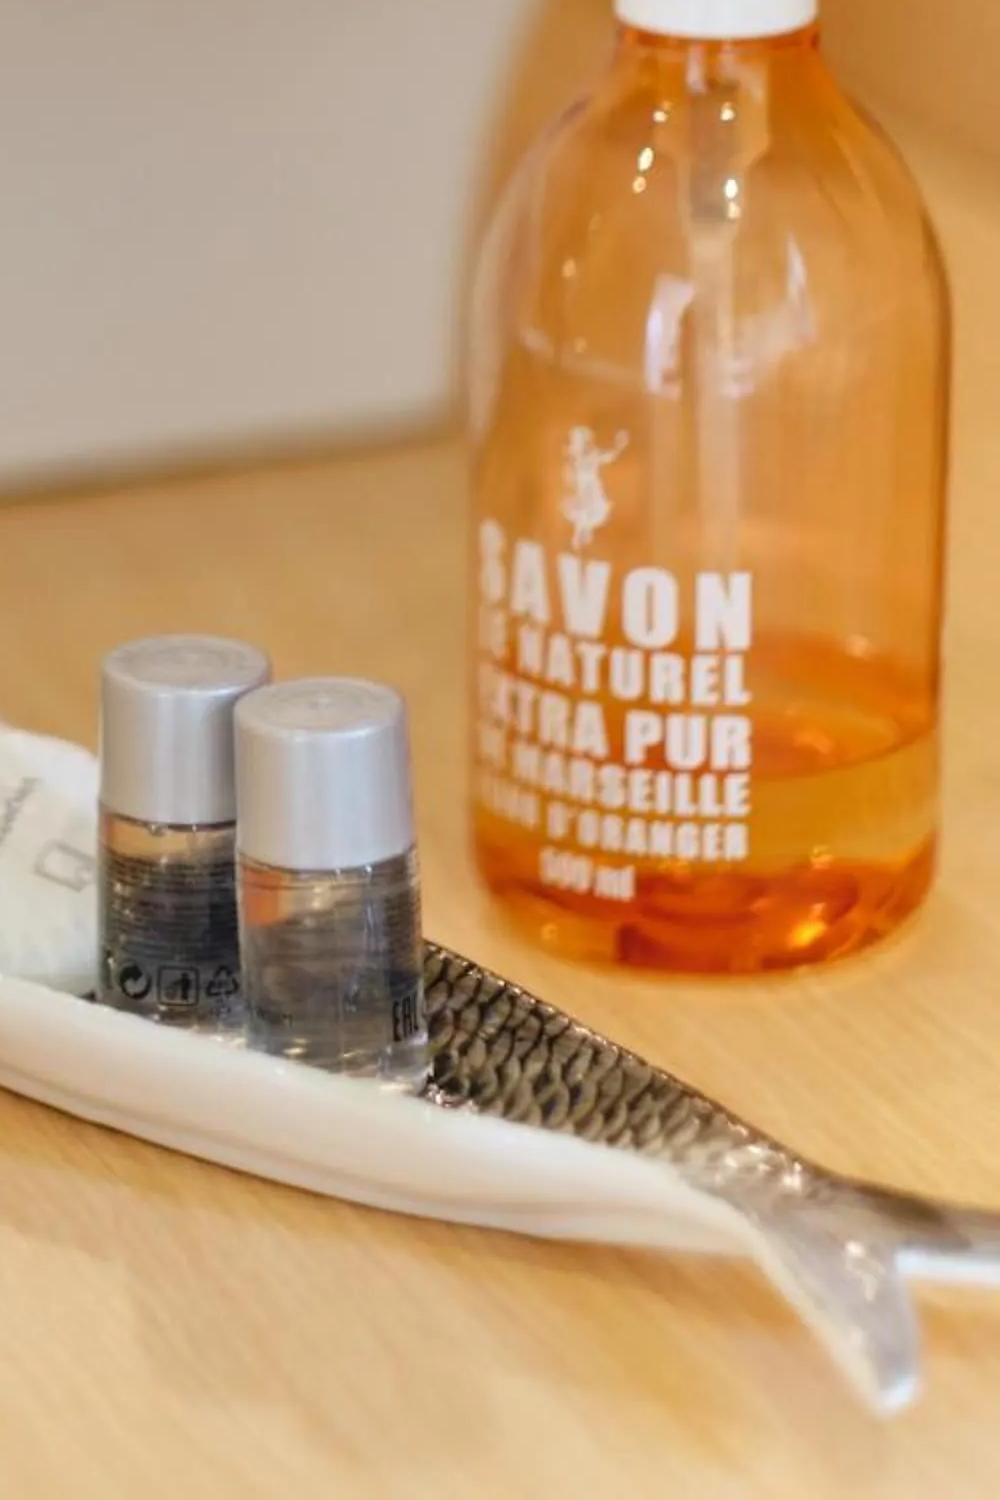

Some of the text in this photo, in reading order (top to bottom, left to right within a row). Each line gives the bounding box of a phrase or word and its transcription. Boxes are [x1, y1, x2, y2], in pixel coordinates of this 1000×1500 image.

[479, 518, 752, 652] SAVON
[518, 623, 752, 707] NATUREL
[513, 739, 751, 818] MARSEILLE
[624, 709, 752, 771] PUR
